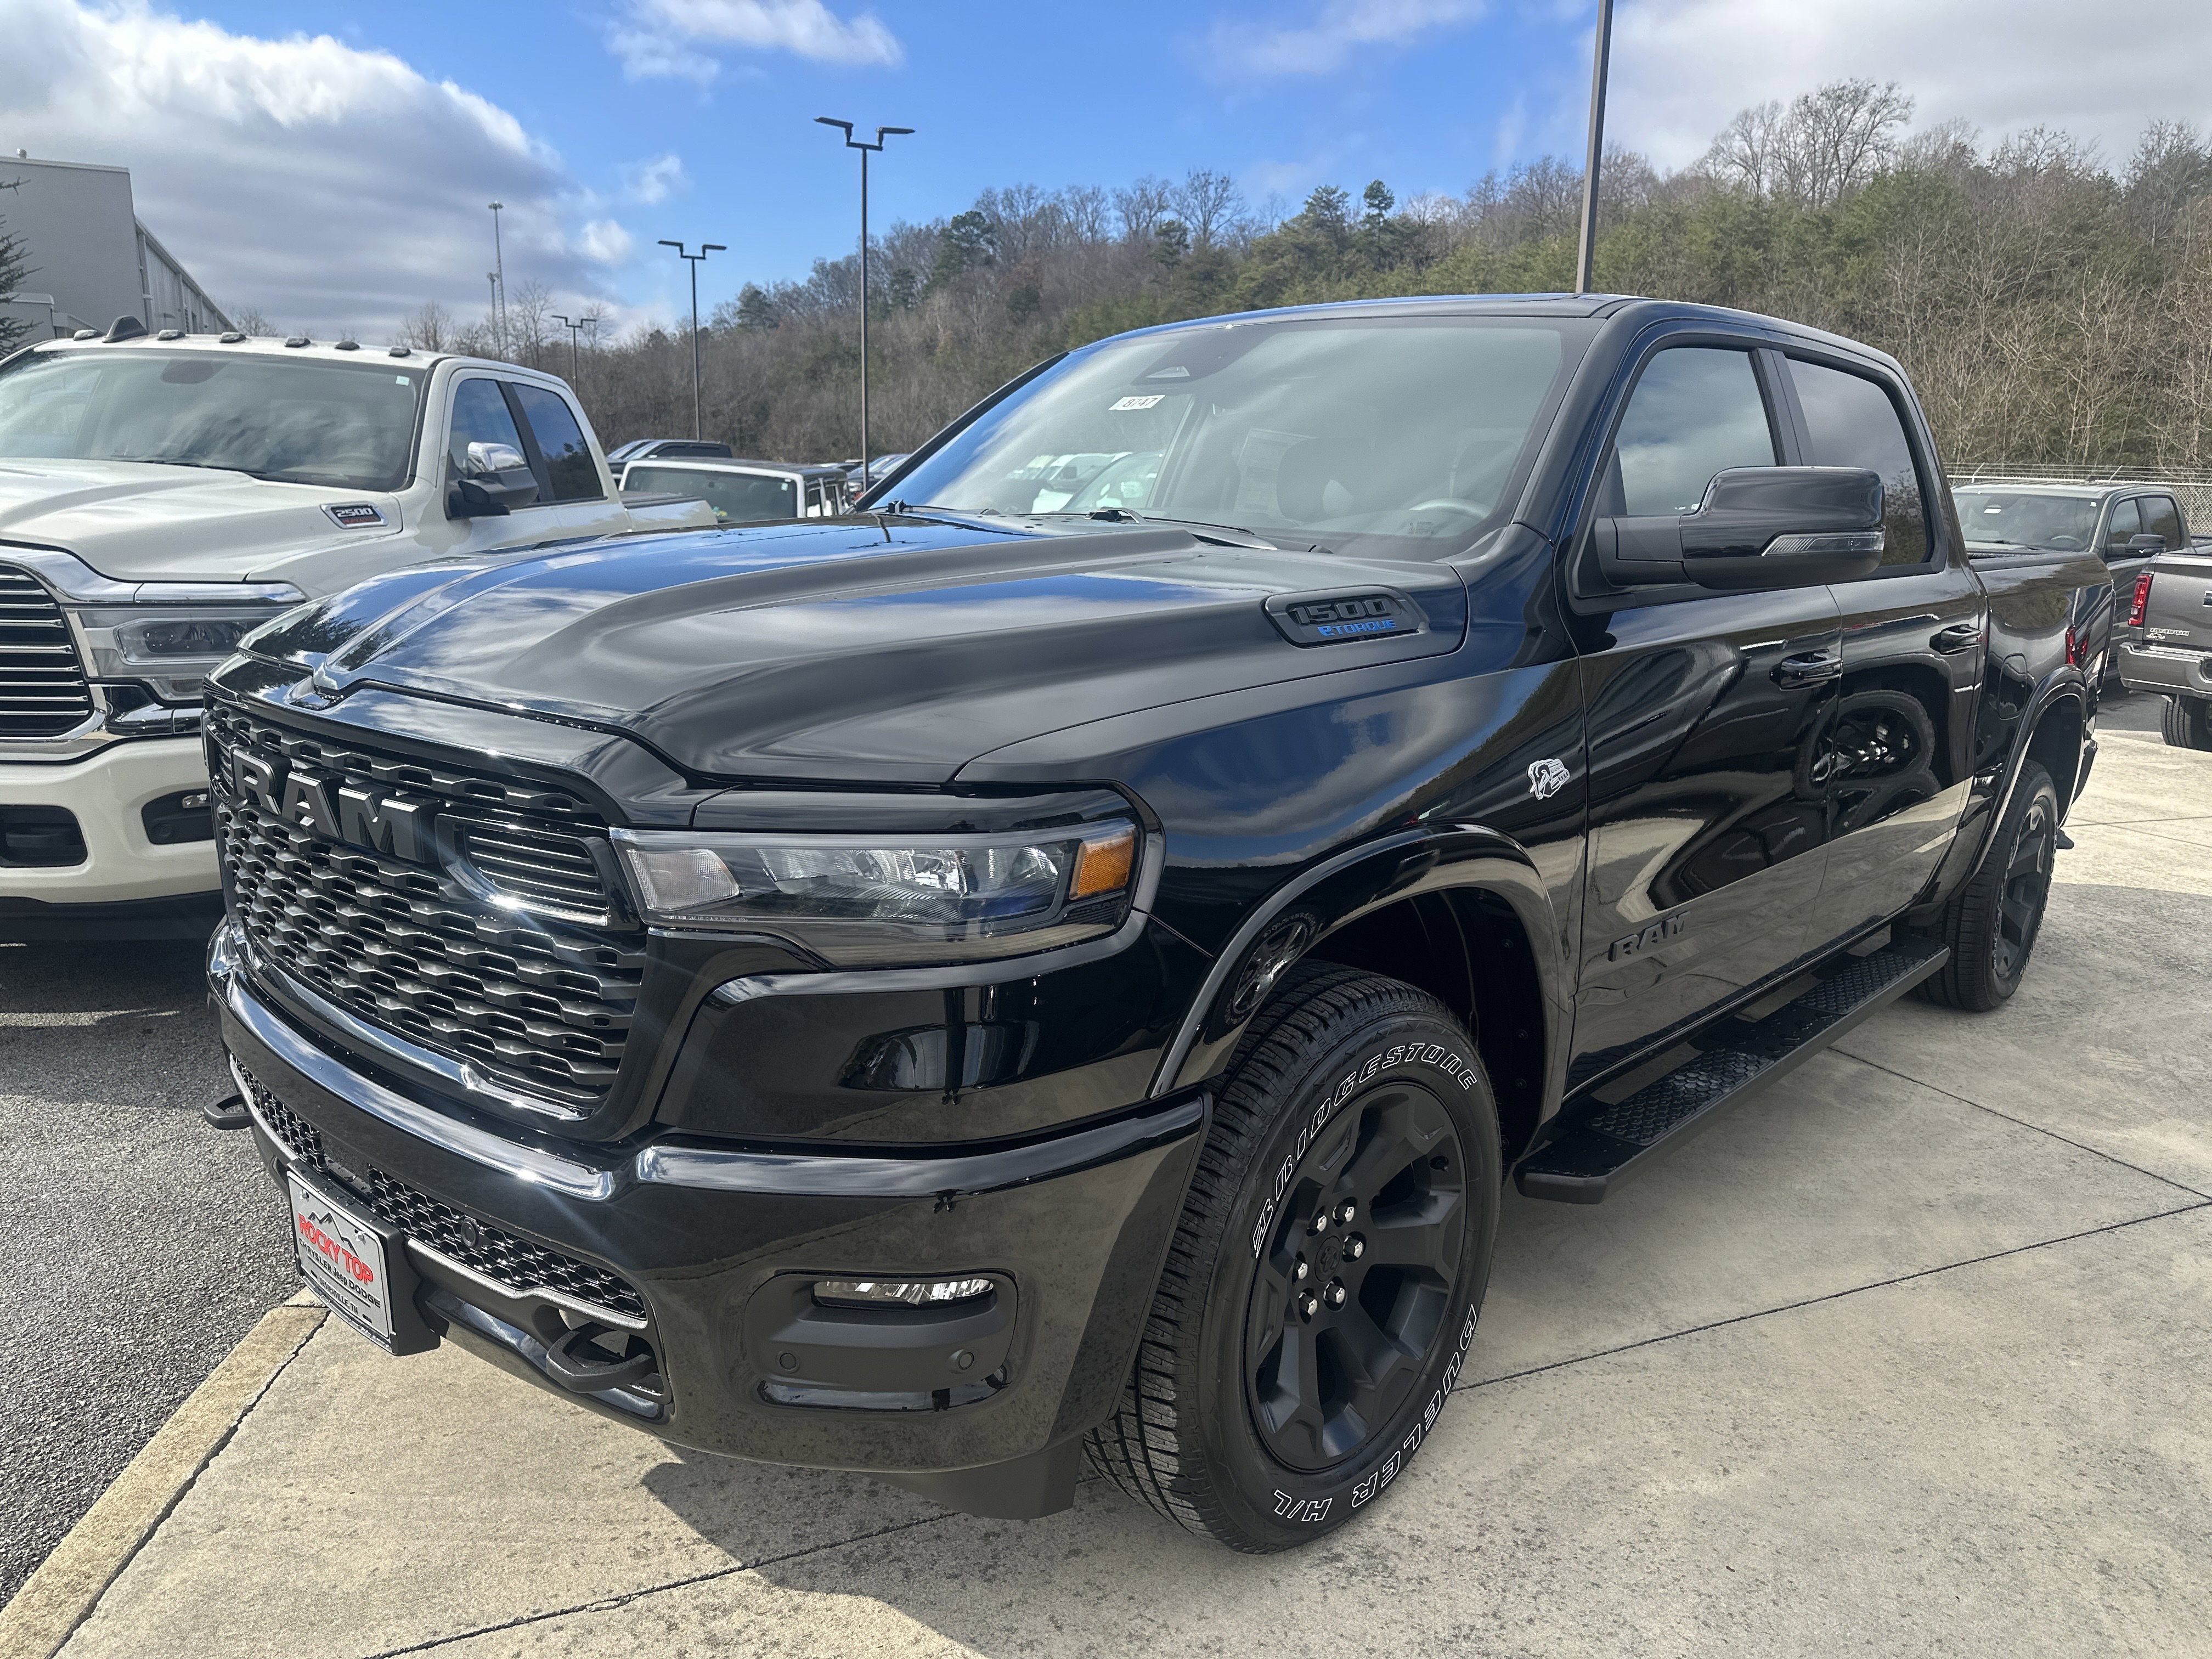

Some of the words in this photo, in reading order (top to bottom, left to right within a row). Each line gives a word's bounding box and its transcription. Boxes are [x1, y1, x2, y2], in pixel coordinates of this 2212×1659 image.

[1122, 397, 1159, 408] 8747
[335, 507, 373, 517] 2500
[1289, 598, 1392, 626] 1500
[233, 748, 431, 863] RAM
[1608, 910, 1691, 962] RAM
[1252, 1043, 1477, 1259] BRIDGESTONE
[298, 1212, 340, 1264] ROCKY
[342, 1248, 374, 1285] TOP
[299, 1238, 332, 1271] CHRYSLER
[333, 1265, 348, 1286] Jeep
[349, 1278, 381, 1308] DODGE
[350, 1302, 358, 1314] TN
[1352, 1304, 1477, 1508] DUELER
[1274, 1489, 1332, 1521] H/L
